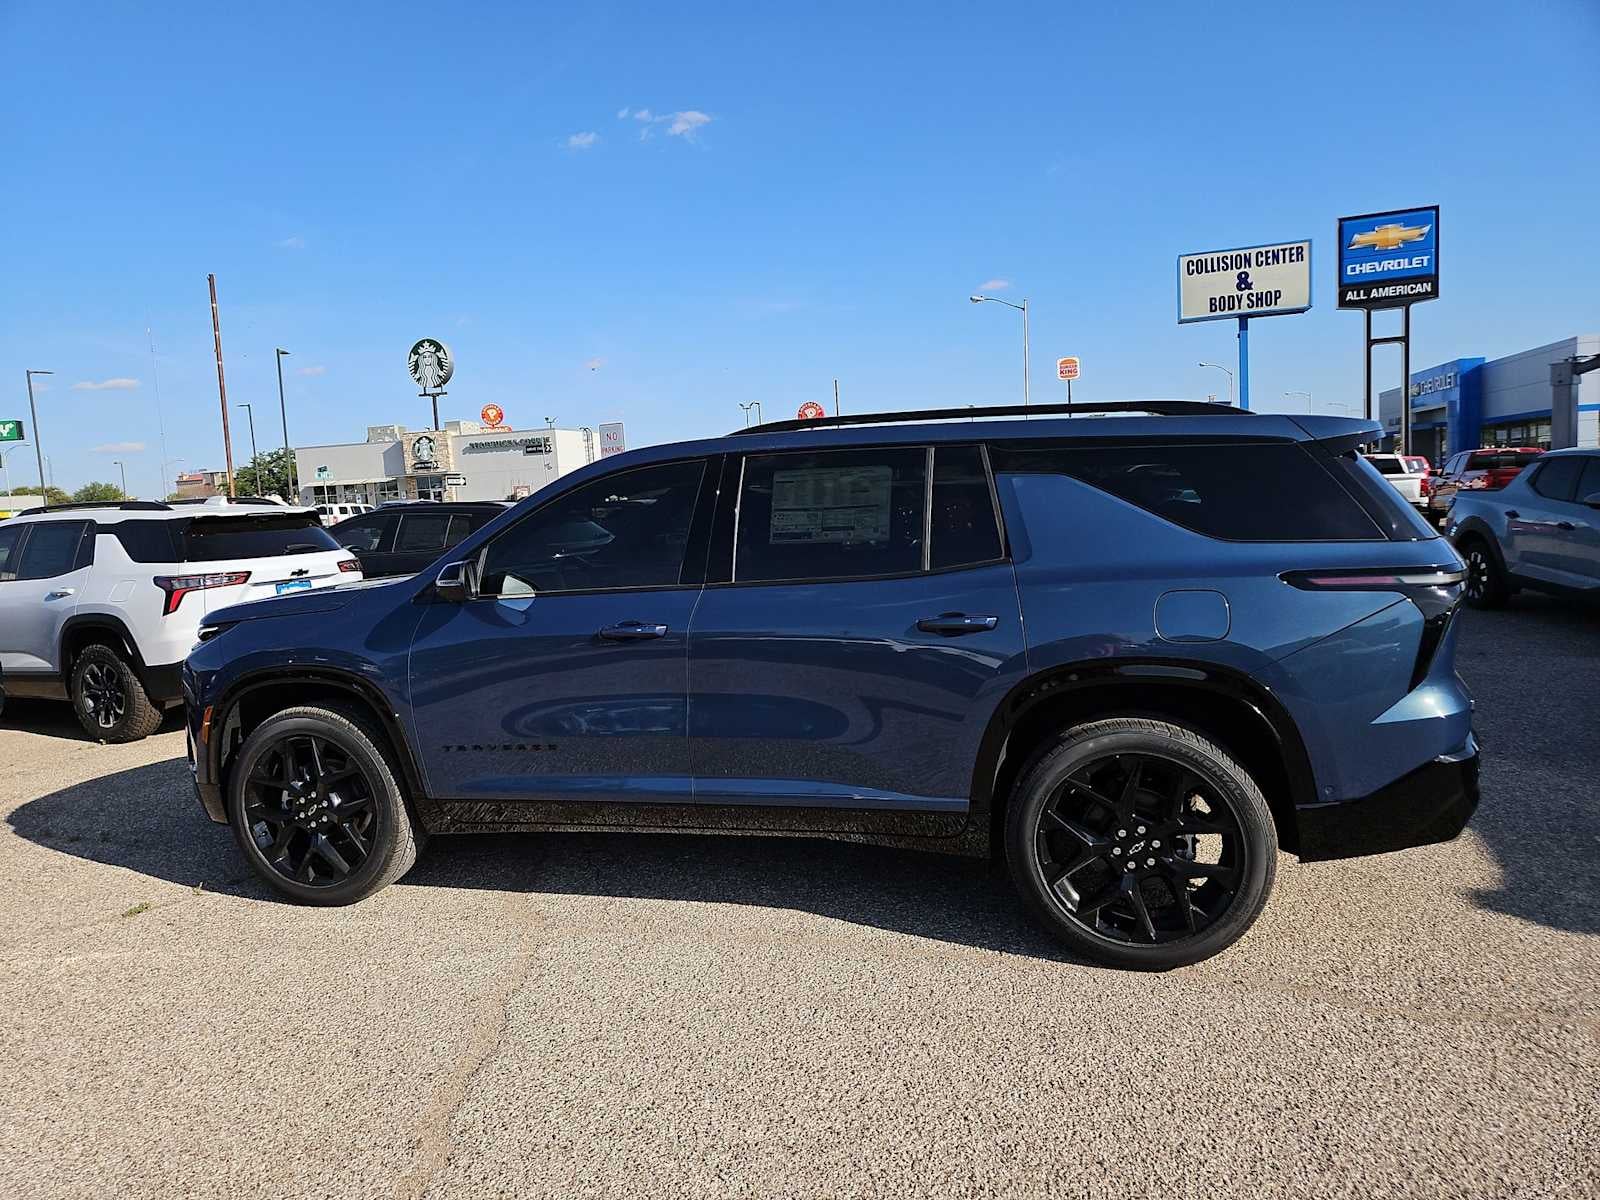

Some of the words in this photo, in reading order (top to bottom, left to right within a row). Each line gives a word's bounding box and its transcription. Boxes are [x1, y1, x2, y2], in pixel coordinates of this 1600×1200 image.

[1186, 252, 1251, 276] COLLISION
[1255, 245, 1304, 267] CENTER
[1346, 255, 1431, 275] CHEVROLET
[1236, 270, 1254, 292] &
[1345, 289, 1368, 301] ALL
[1370, 282, 1432, 298] AMERICAN
[1209, 293, 1244, 313] BODY
[1246, 290, 1282, 309] SHOP
[1059, 367, 1078, 375] KING
[606, 431, 618, 441] NO
[441, 743, 559, 753] TRAVERSE
